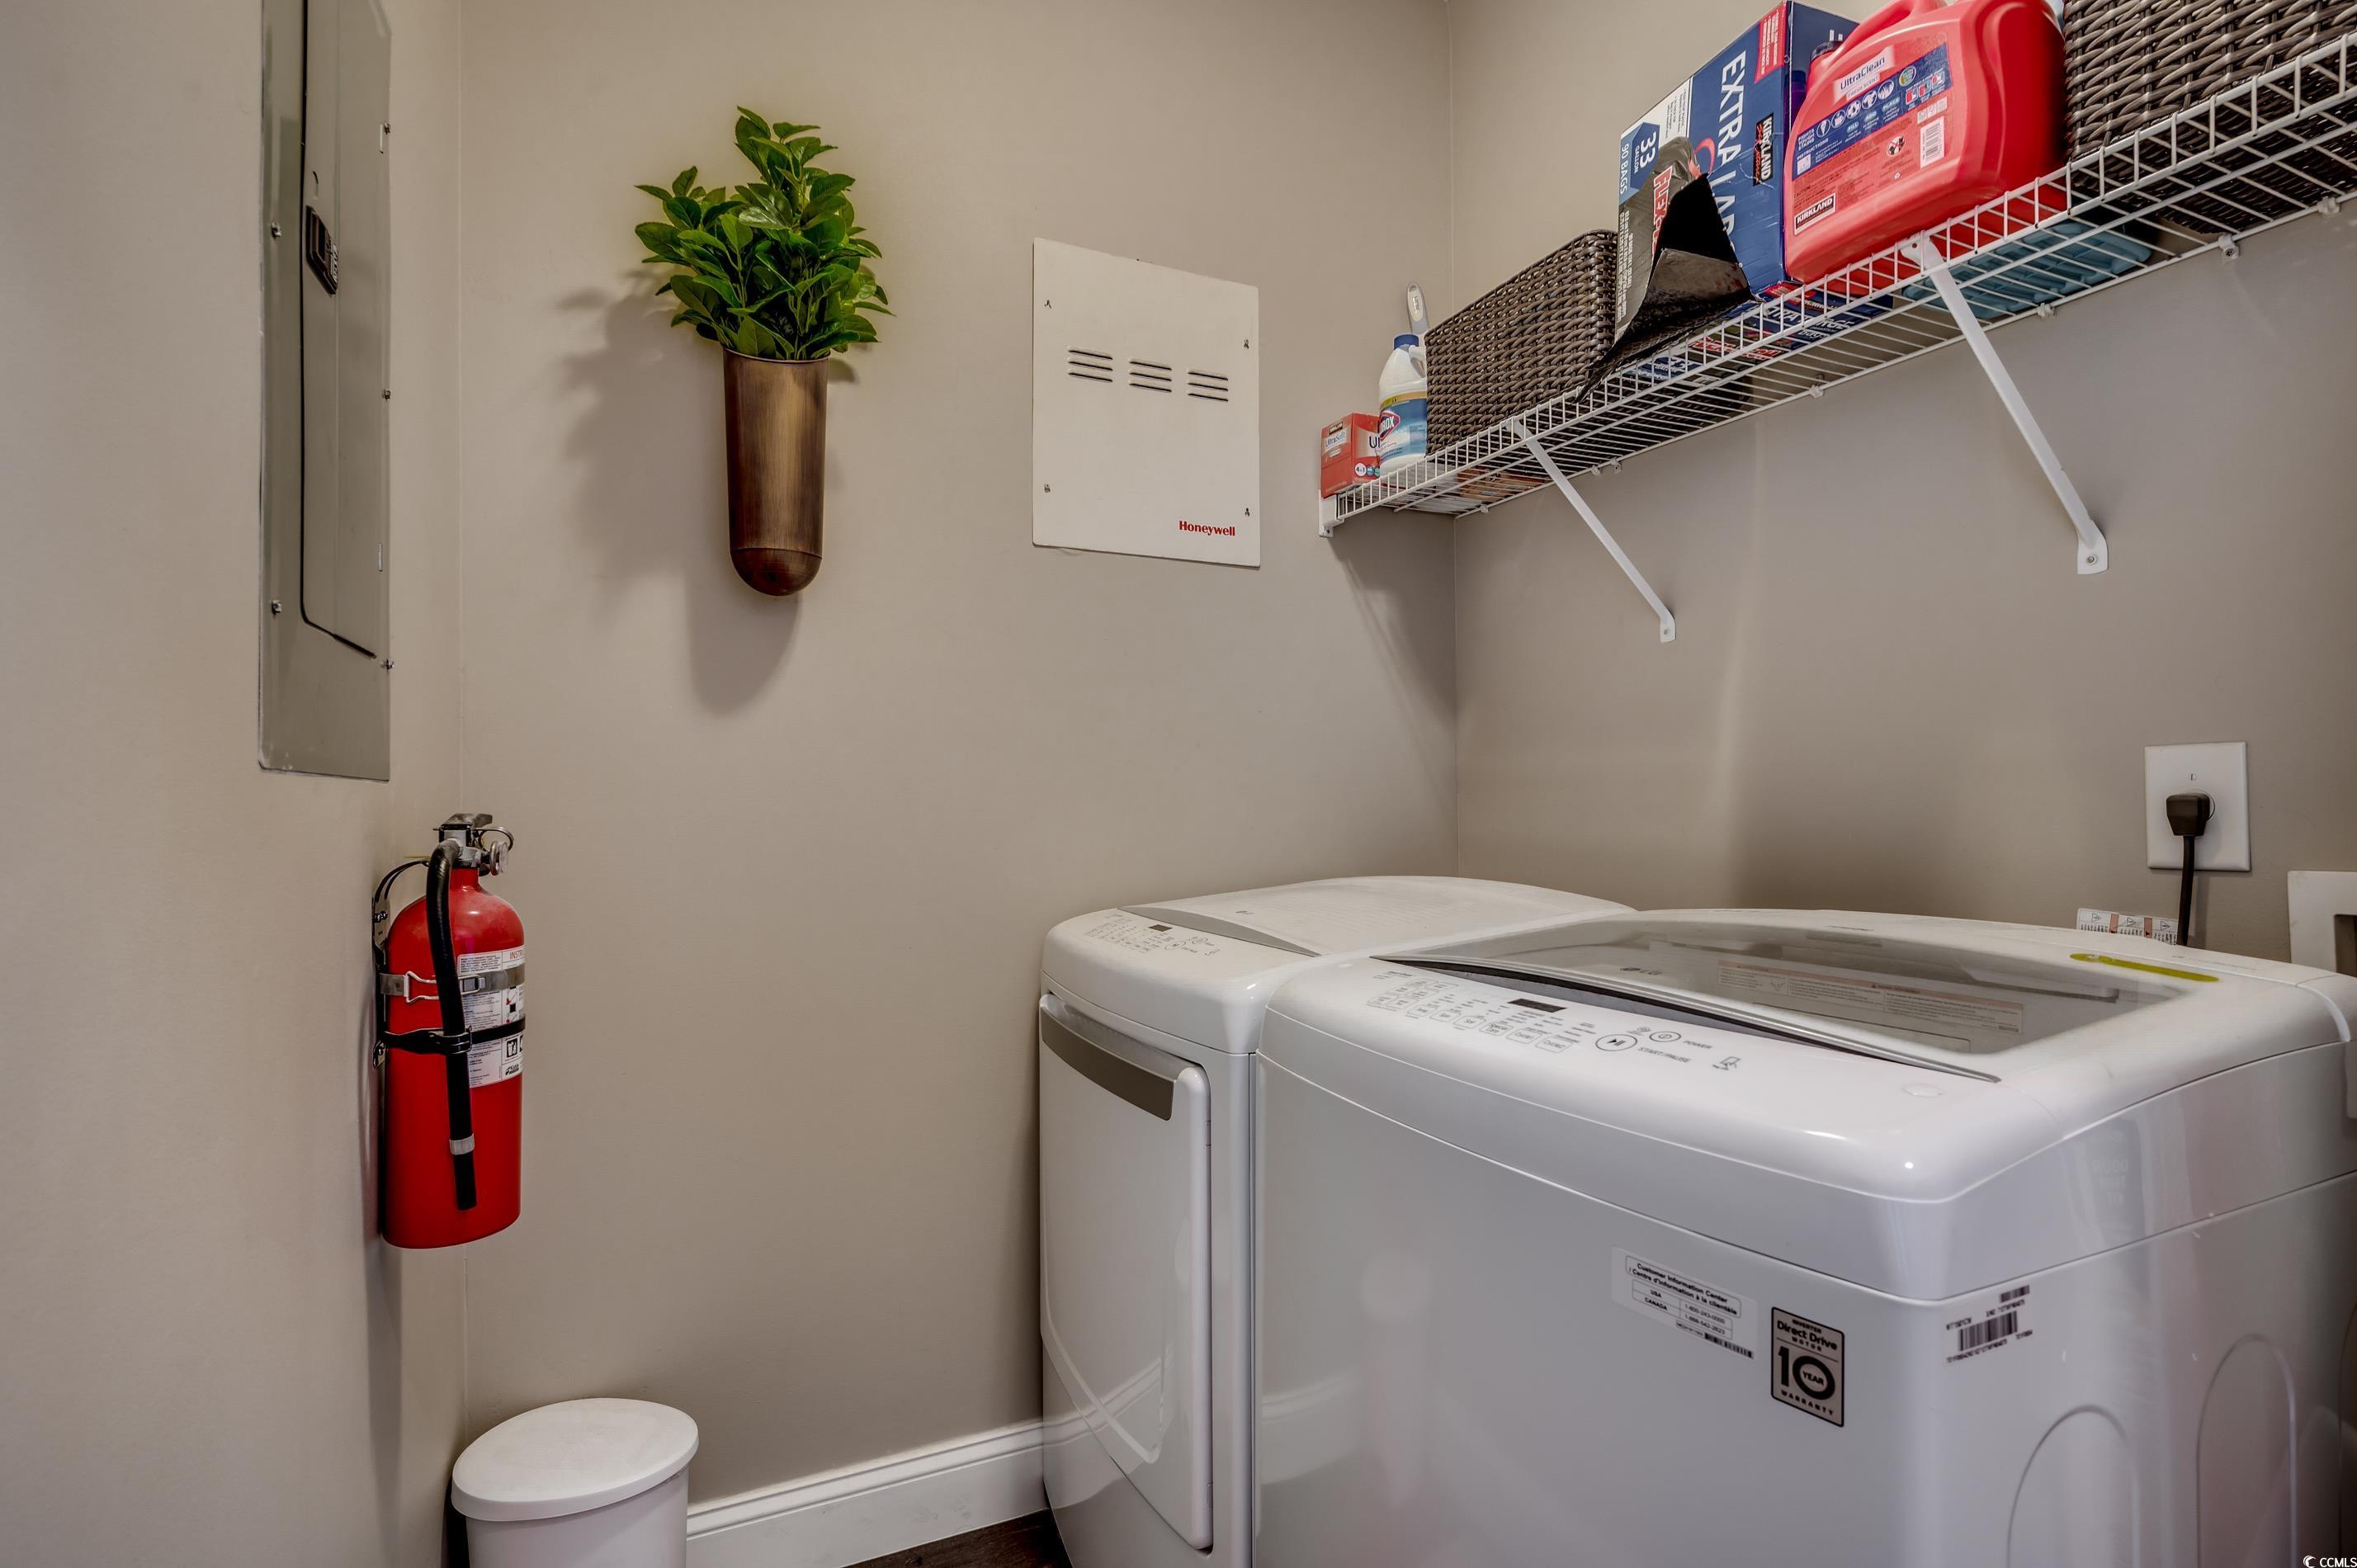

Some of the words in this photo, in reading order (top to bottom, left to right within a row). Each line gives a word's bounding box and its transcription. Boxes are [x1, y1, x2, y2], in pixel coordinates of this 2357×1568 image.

[1840, 57, 1885, 89] UltraClean
[1717, 50, 1746, 167] EXTRA
[1622, 144, 1629, 159] 90
[1640, 131, 1656, 168] 33
[1760, 116, 1773, 181] KIRKLAND
[1620, 164, 1628, 194] BAGS
[1797, 197, 1834, 224] KIRKLAND
[1178, 520, 1235, 536] Honeywell
[1684, 1040, 1712, 1050] POWER
[1632, 1268, 1652, 1282] Centre
[1637, 1263, 1666, 1279] Customer
[1667, 1274, 1704, 1295] Information
[1705, 1290, 1728, 1303] Center
[1644, 1296, 1668, 1311] CANADA
[1651, 1289, 1662, 1298] USA
[1777, 1320, 1807, 1339] Direct
[1809, 1332, 1838, 1350] Drive
[1792, 1319, 1822, 1334] INVERTER
[1792, 1336, 1822, 1352] MOTOR
[1778, 1346, 1836, 1400] 10
[1802, 1371, 1825, 1386] YEAR
[1781, 1389, 1834, 1415] WARRANTY
